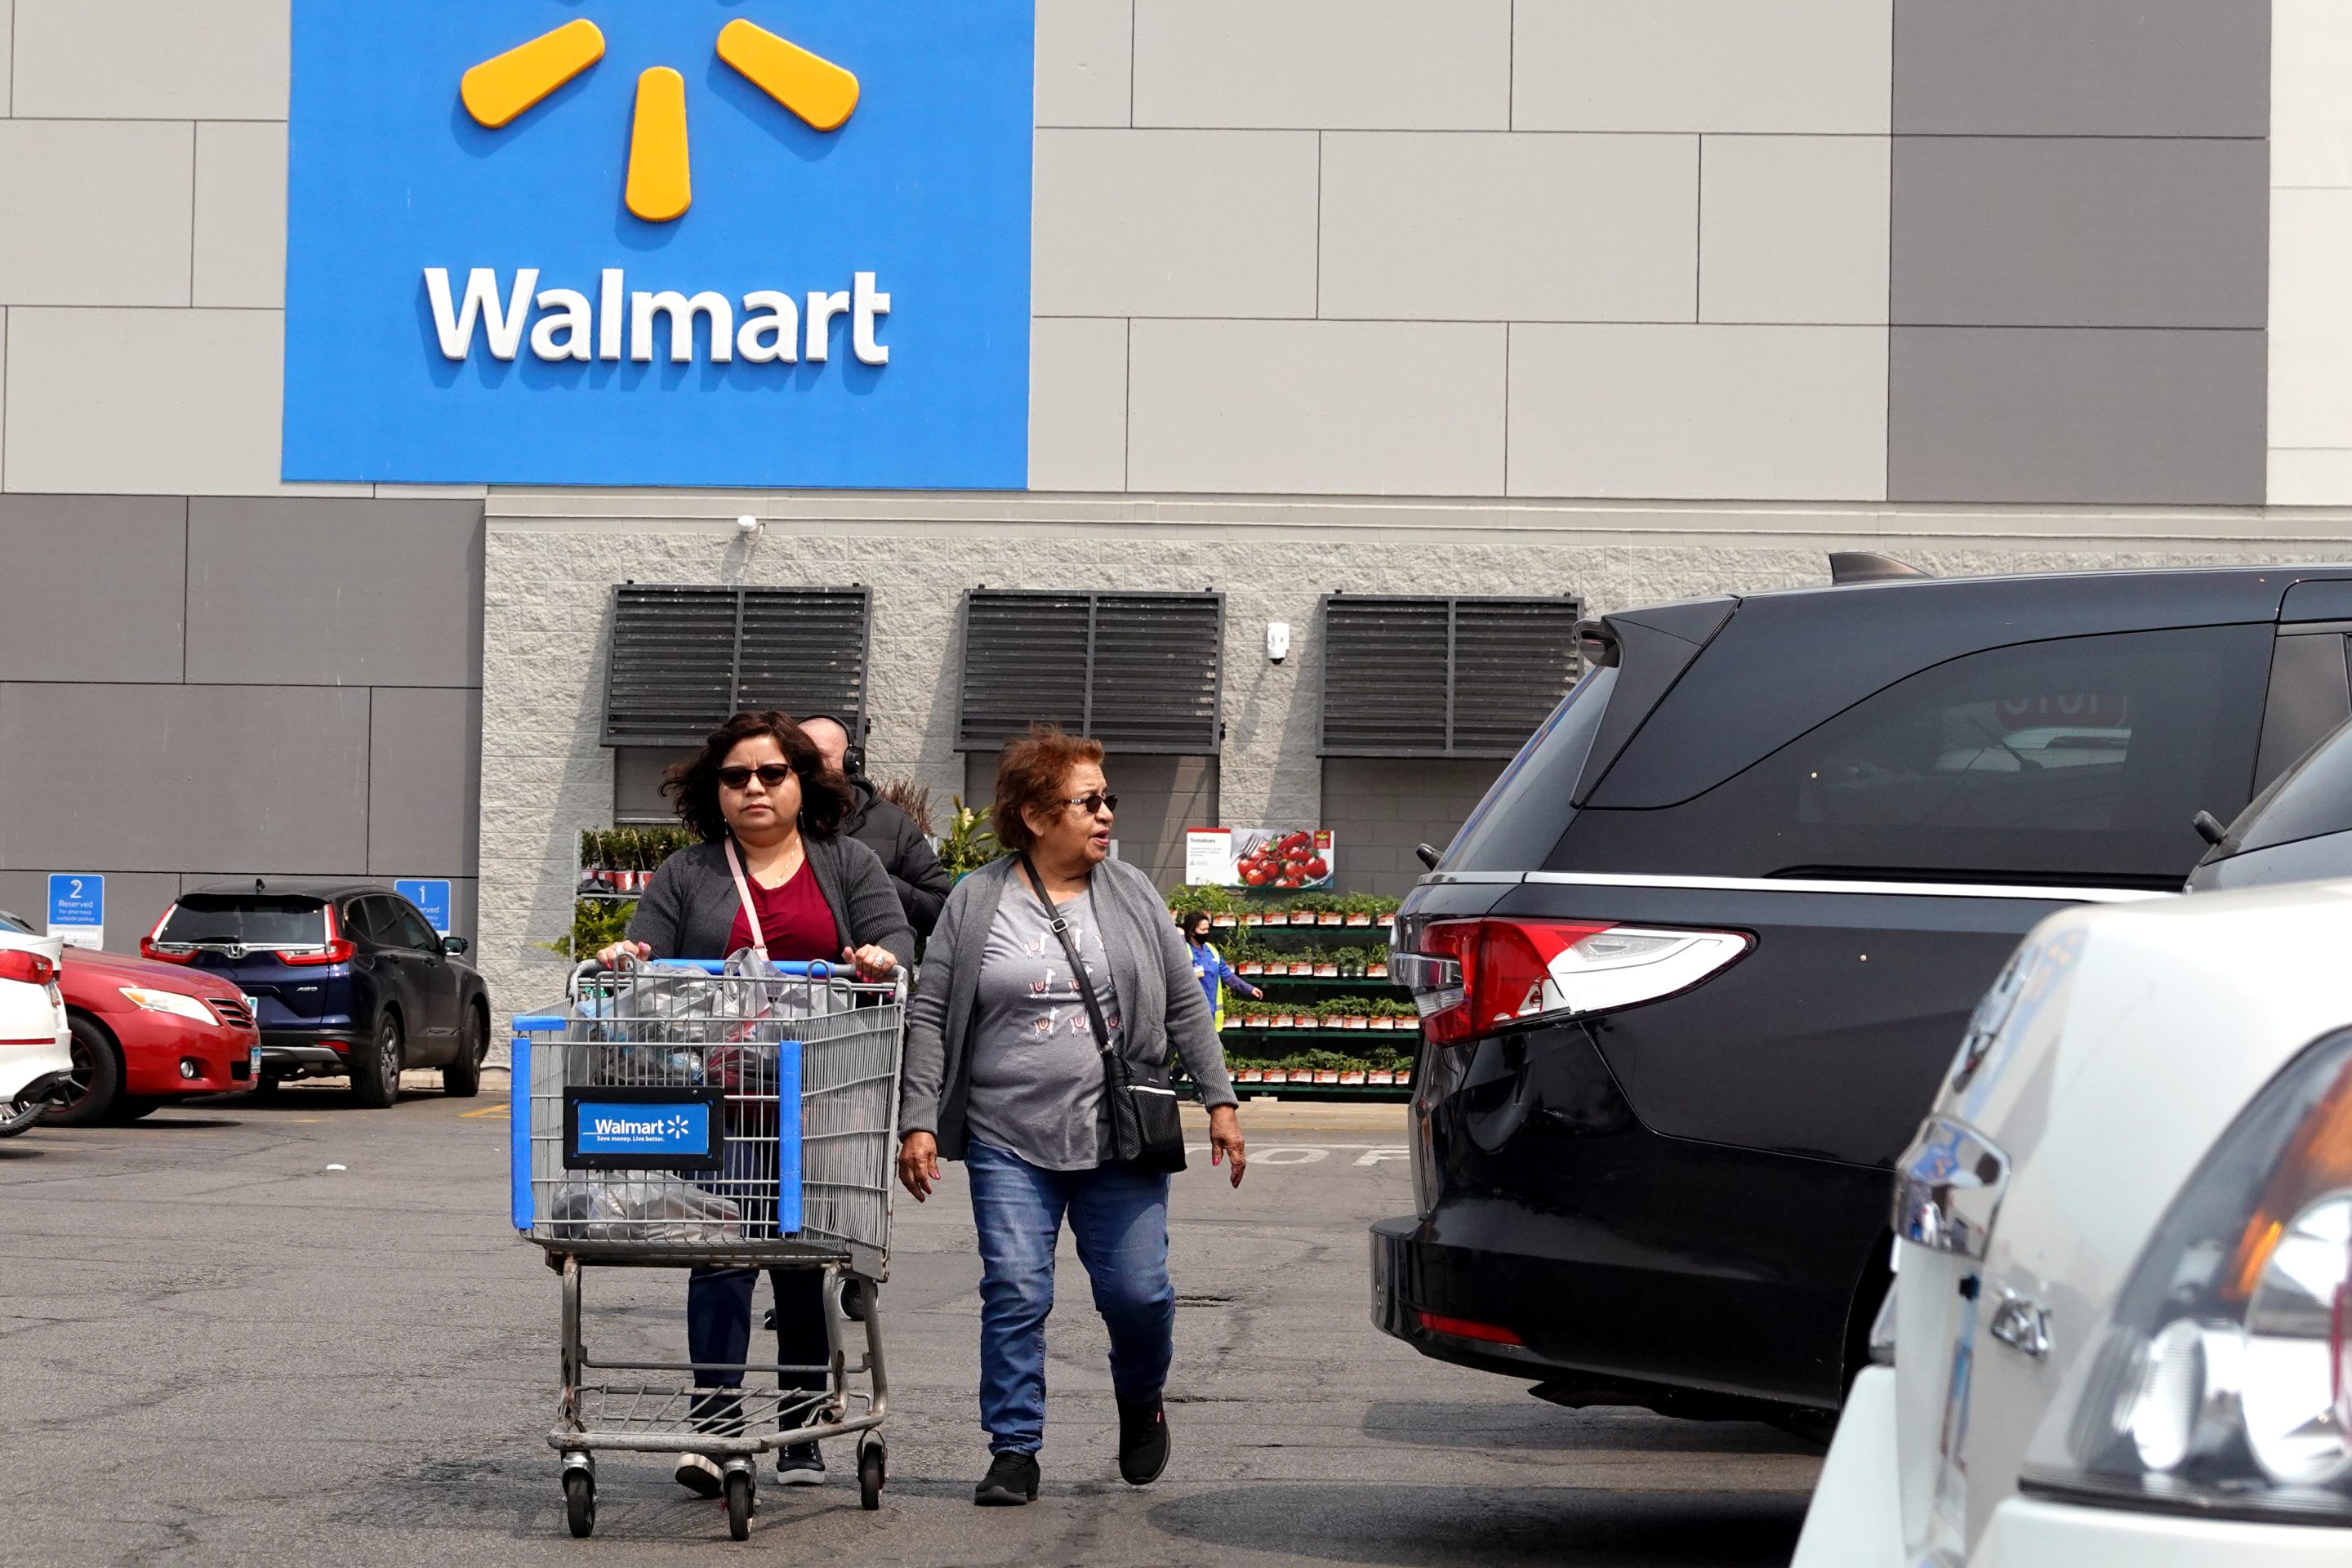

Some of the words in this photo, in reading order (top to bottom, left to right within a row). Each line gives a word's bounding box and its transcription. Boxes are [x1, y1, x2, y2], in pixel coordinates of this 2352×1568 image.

[424, 268, 890, 365] Walmart
[69, 879, 82, 898] 2
[419, 885, 425, 904] 1
[58, 899, 93, 908] Reserved
[595, 1118, 664, 1135] Walmart
